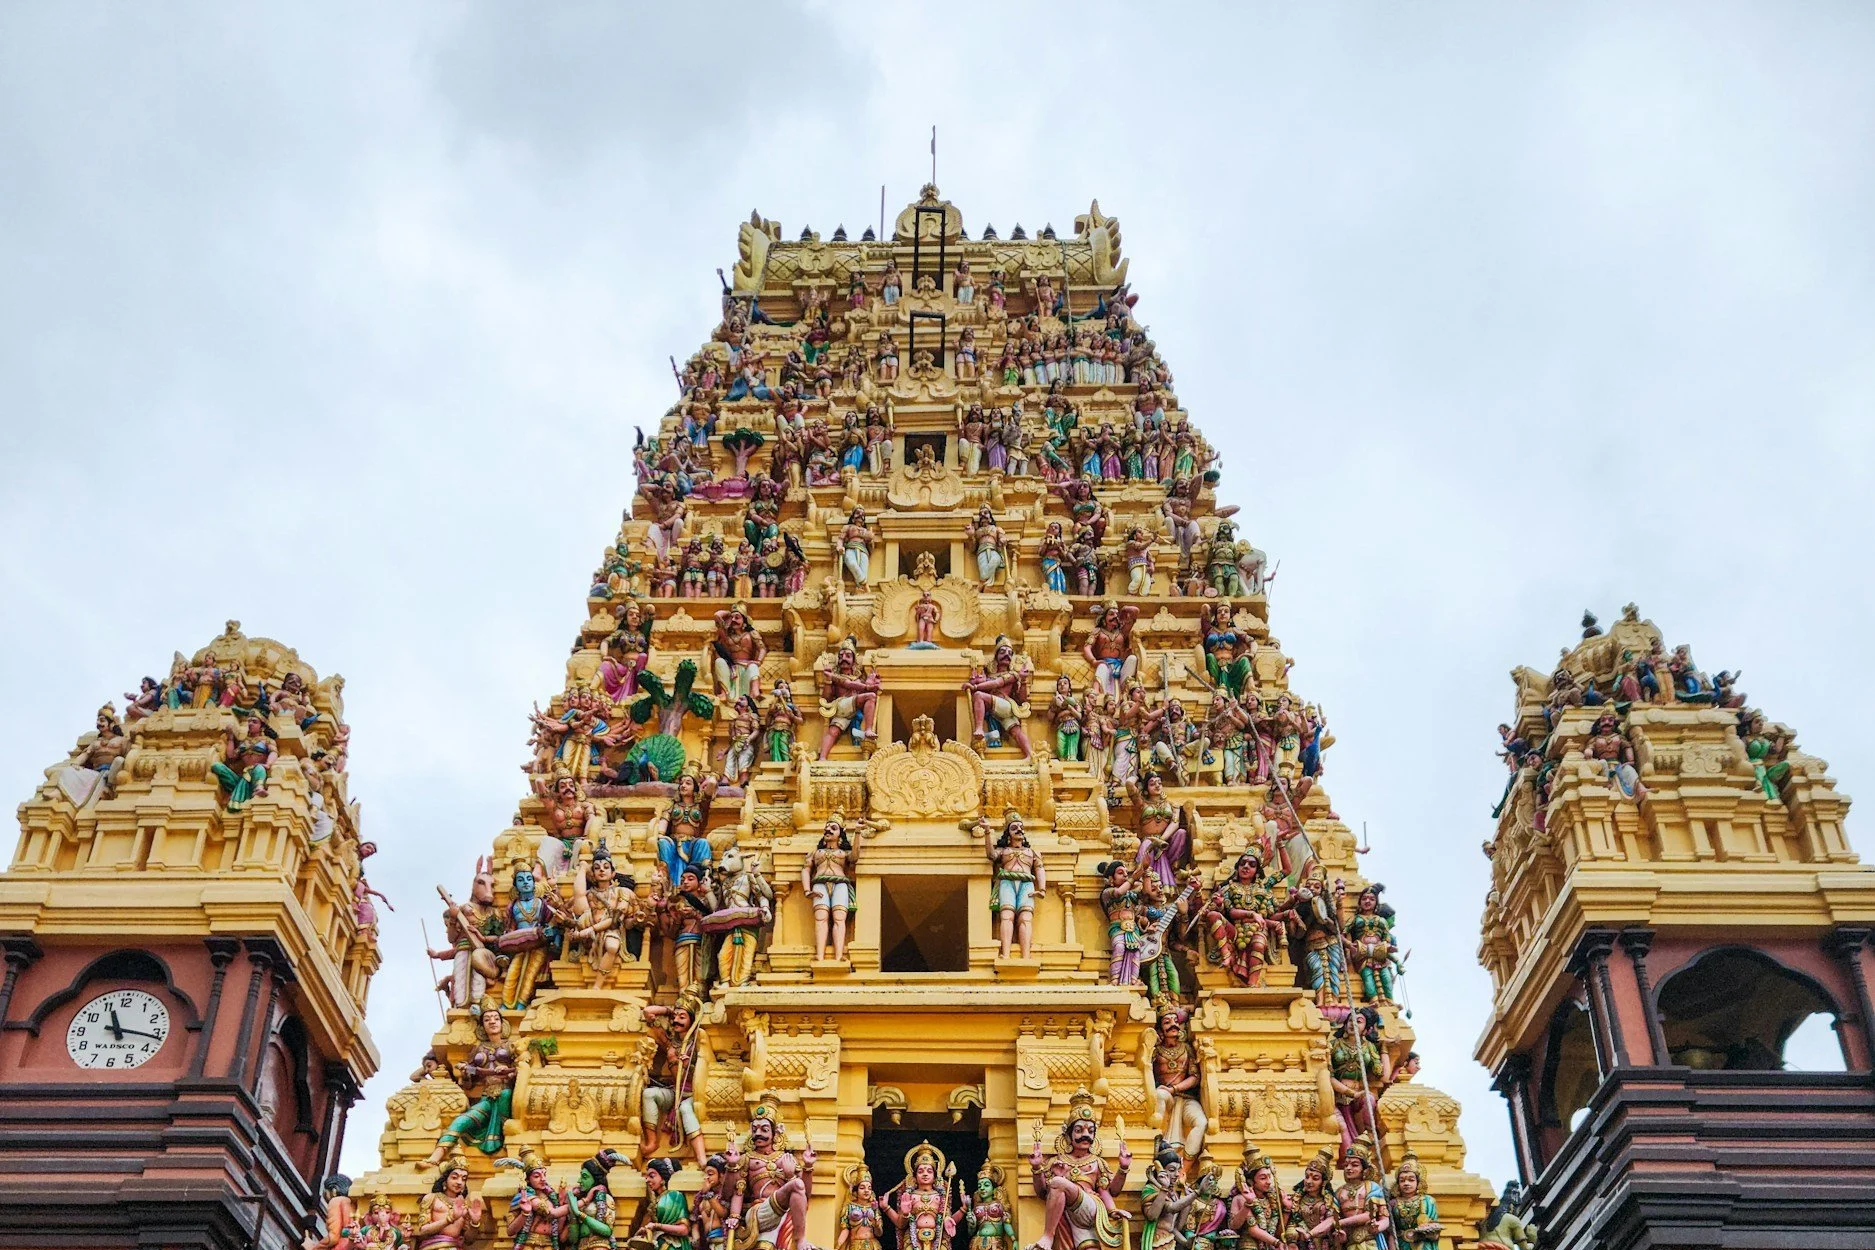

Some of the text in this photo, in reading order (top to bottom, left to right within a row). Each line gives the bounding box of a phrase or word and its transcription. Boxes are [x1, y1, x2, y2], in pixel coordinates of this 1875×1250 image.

[104, 1002, 113, 1012] 11
[120, 997, 133, 1008] 12
[142, 1003, 147, 1013] 1
[87, 1012, 100, 1023] 10
[150, 1014, 159, 1024] 2
[76, 1027, 86, 1037] 9
[152, 1028, 161, 1038] 3
[78, 1040, 88, 1050] 8
[141, 1042, 150, 1053] 4
[90, 1053, 98, 1063] 7
[106, 1057, 115, 1068] 6
[124, 1053, 134, 1064] 5
